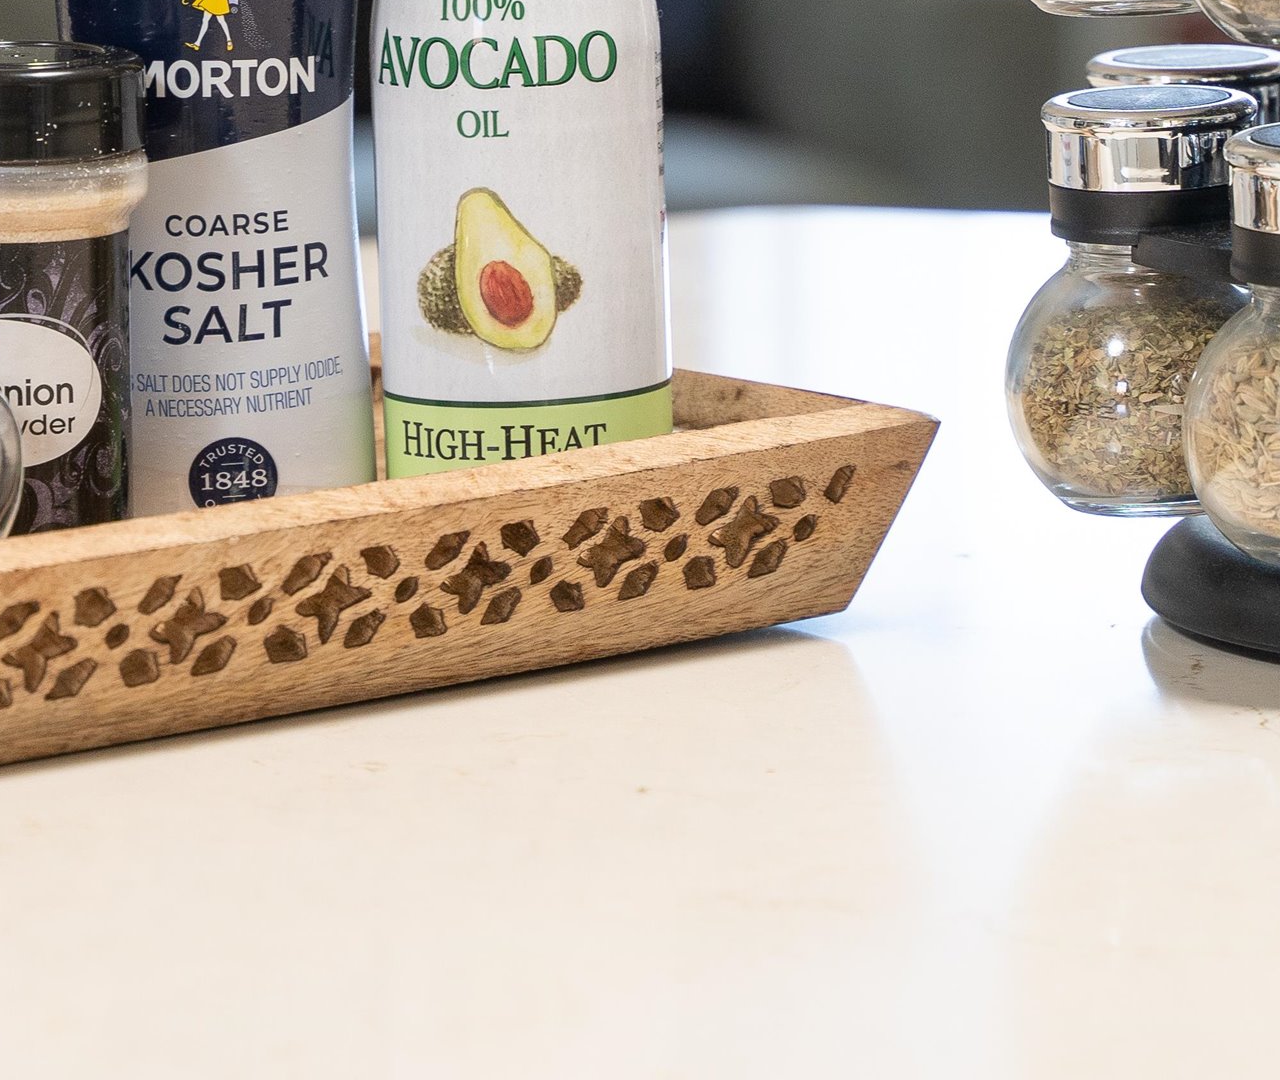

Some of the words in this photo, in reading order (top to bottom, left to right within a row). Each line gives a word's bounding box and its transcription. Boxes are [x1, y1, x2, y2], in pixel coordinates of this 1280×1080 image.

[379, 27, 618, 90] AVOCADO
[143, 56, 317, 99] MORTON
[456, 110, 510, 138] OIL
[165, 210, 289, 238] COARSE
[130, 241, 329, 293] KOSHER
[162, 299, 293, 346] SALT
[136, 373, 168, 393] SALT
[172, 374, 211, 393] DOES
[215, 372, 246, 392] NOT
[250, 364, 302, 389] SUPPLY
[145, 399, 156, 417] A
[158, 397, 242, 418] NECESSARY
[246, 387, 313, 414] NUTRIENT
[199, 444, 265, 469] TRUSTED
[200, 469, 268, 491] 1848
